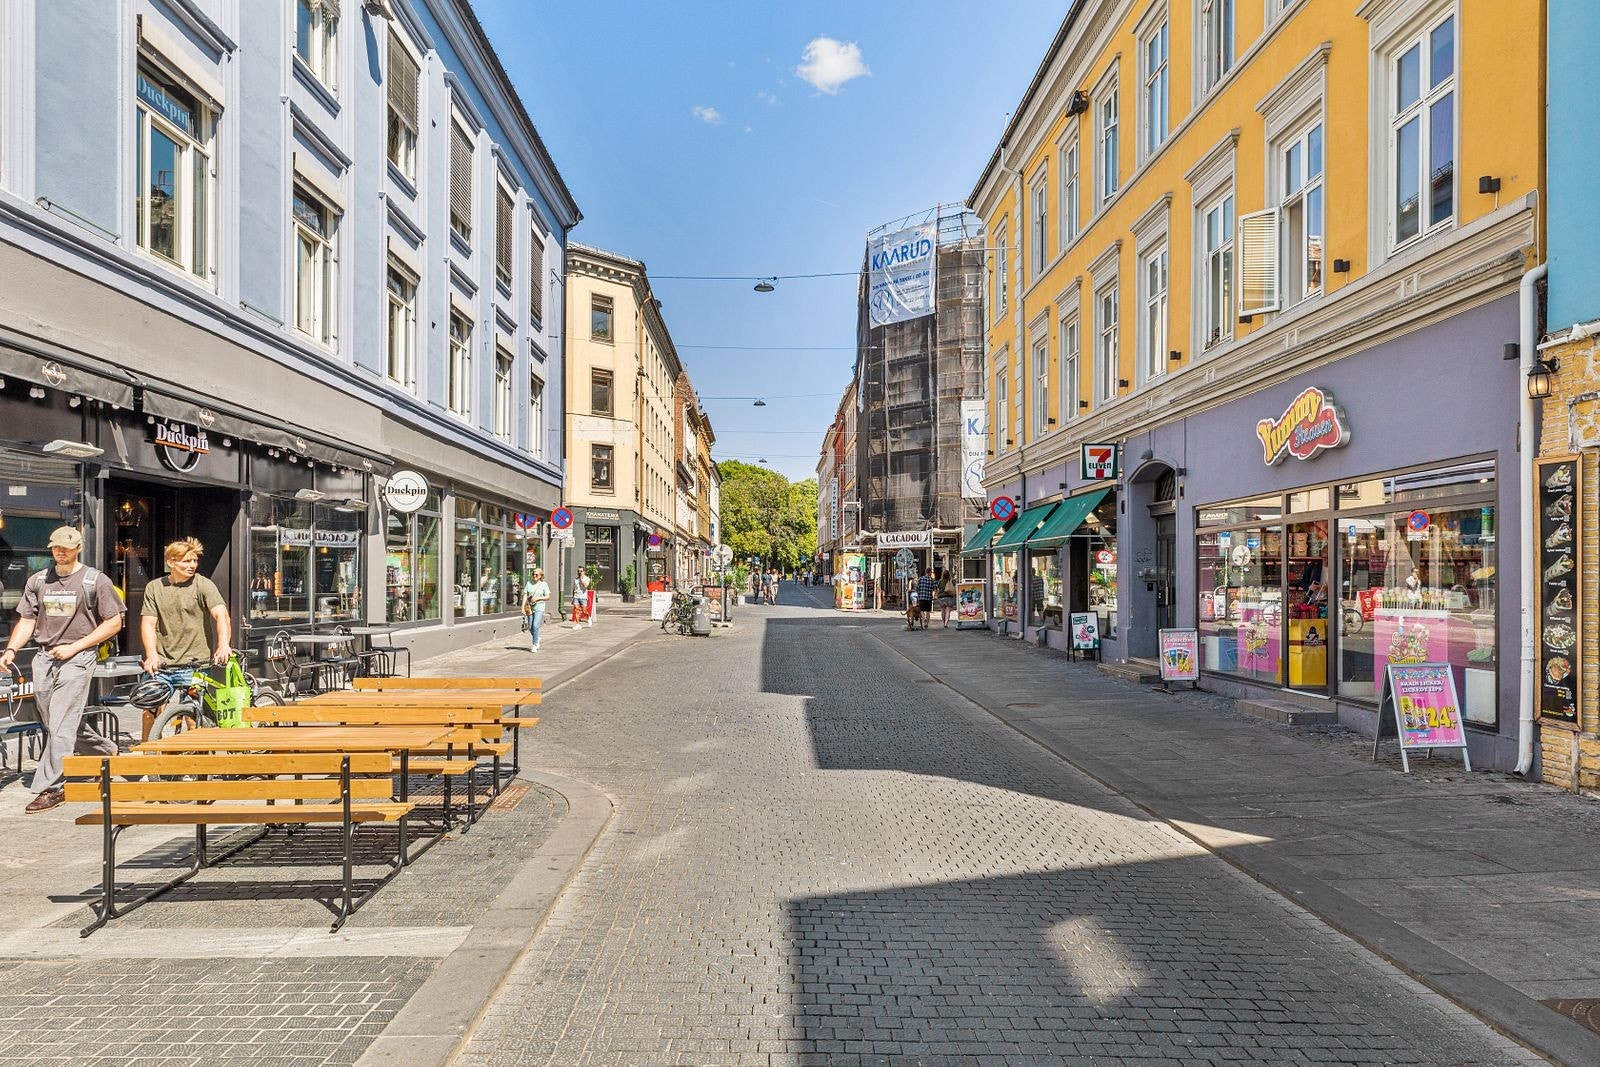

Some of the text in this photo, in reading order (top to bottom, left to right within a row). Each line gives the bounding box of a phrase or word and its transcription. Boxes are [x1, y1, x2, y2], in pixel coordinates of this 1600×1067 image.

[138, 77, 188, 127] Duckpin
[872, 239, 931, 271] KAARUD
[156, 423, 210, 453] Duckpin
[1258, 391, 1322, 462] Yummy
[1294, 419, 1333, 448] Heaven
[1089, 448, 1112, 479] 7
[387, 484, 426, 497] Duckpin
[886, 533, 922, 543] CACADOU
